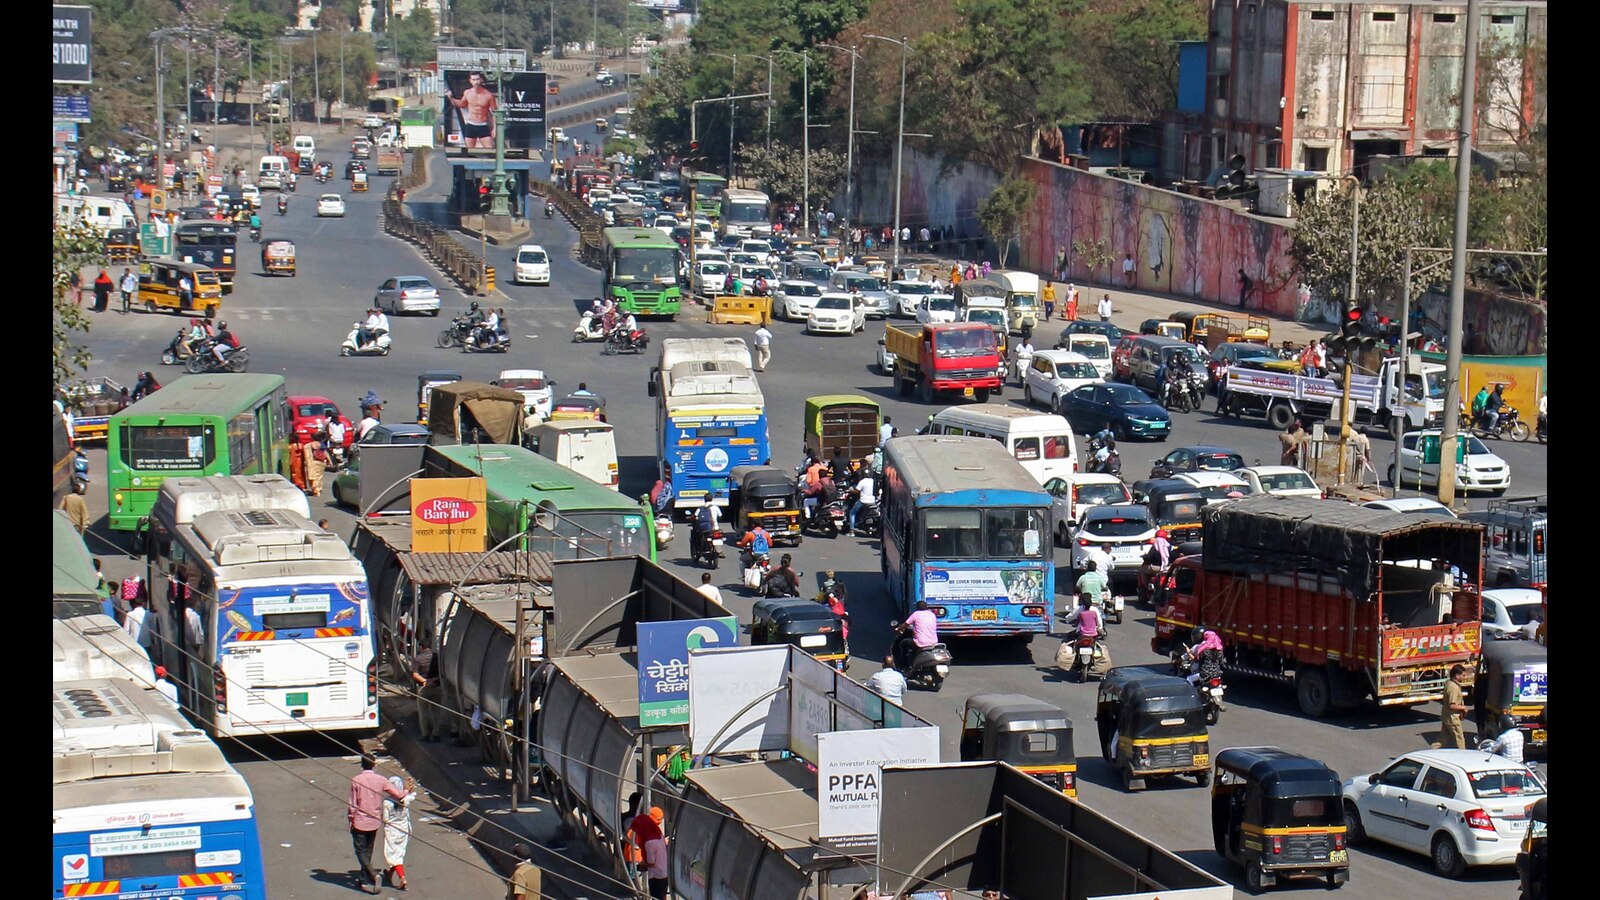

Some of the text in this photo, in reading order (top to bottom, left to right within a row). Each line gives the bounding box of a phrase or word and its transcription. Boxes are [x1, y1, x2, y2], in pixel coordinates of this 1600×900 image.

[433, 500, 460, 511] Ram
[424, 509, 469, 520] Bandhu
[866, 759, 898, 767] Education
[829, 773, 877, 791] PPFA
[829, 793, 869, 802] MUTUAL
